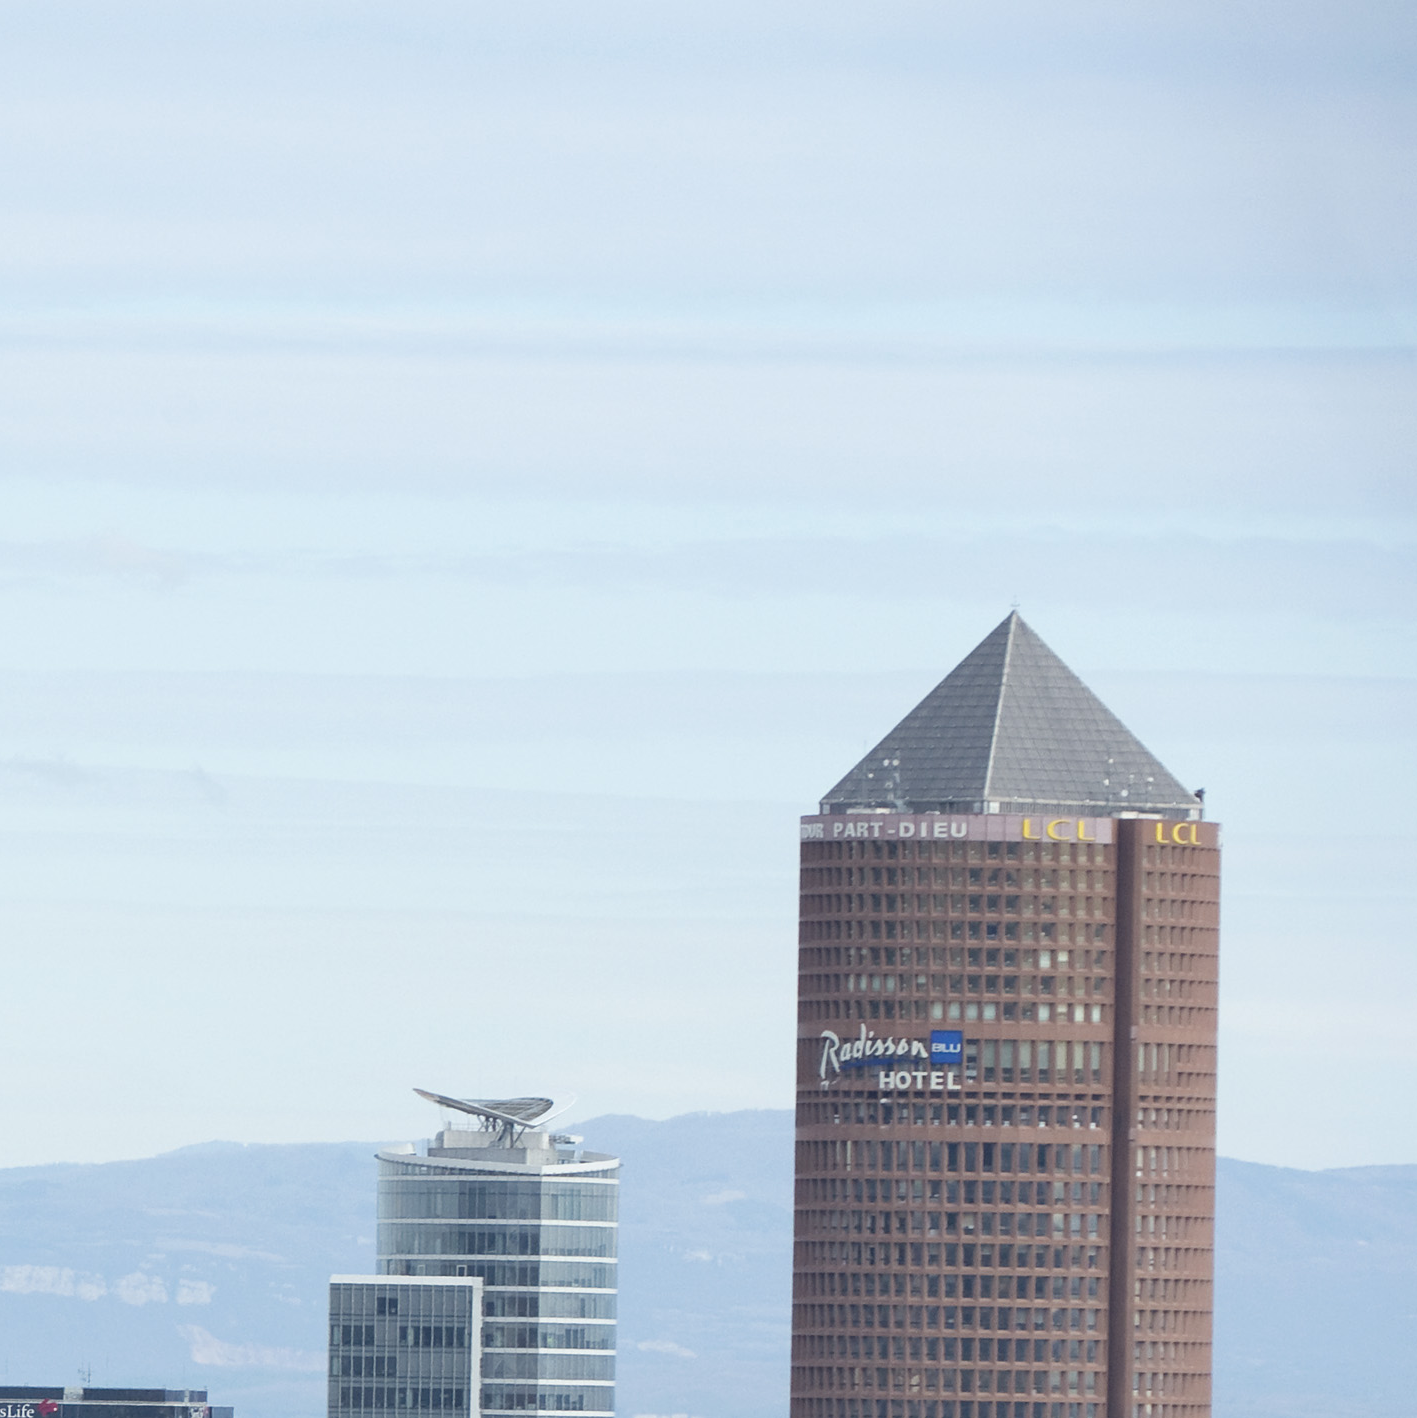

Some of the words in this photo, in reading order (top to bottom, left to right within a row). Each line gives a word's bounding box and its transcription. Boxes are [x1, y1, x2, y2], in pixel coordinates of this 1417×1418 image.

[833, 821, 968, 838] PART-DIEU
[1022, 818, 1096, 841] LCL
[1155, 822, 1202, 845] LCL
[820, 1023, 929, 1079] Radisson
[931, 1043, 961, 1053] BLU
[879, 1071, 962, 1090] HOTEL
